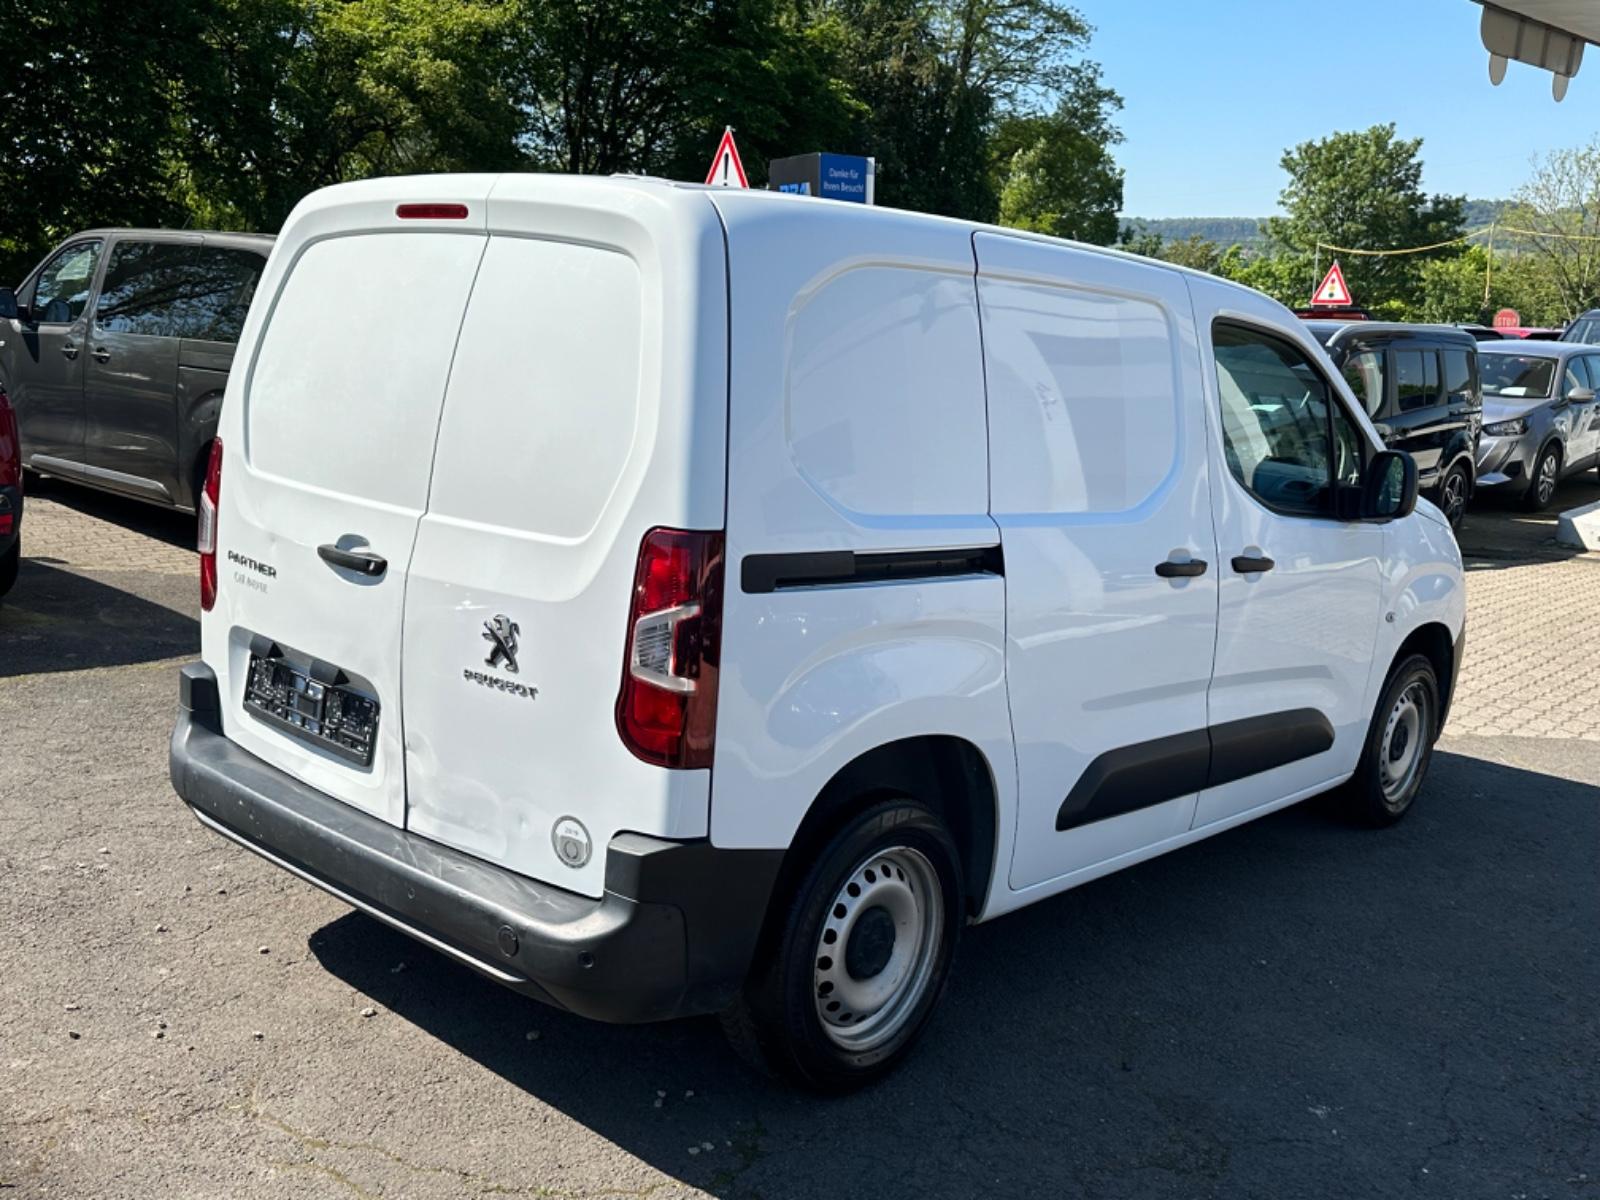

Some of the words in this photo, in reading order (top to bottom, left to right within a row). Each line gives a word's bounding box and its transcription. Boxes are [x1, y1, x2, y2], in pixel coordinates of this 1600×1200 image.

[828, 168, 849, 179] Danke
[823, 182, 840, 192] Ihren
[1496, 316, 1517, 327] STOP
[228, 550, 277, 579] PARTNER
[464, 669, 538, 700] PEUGEOT
